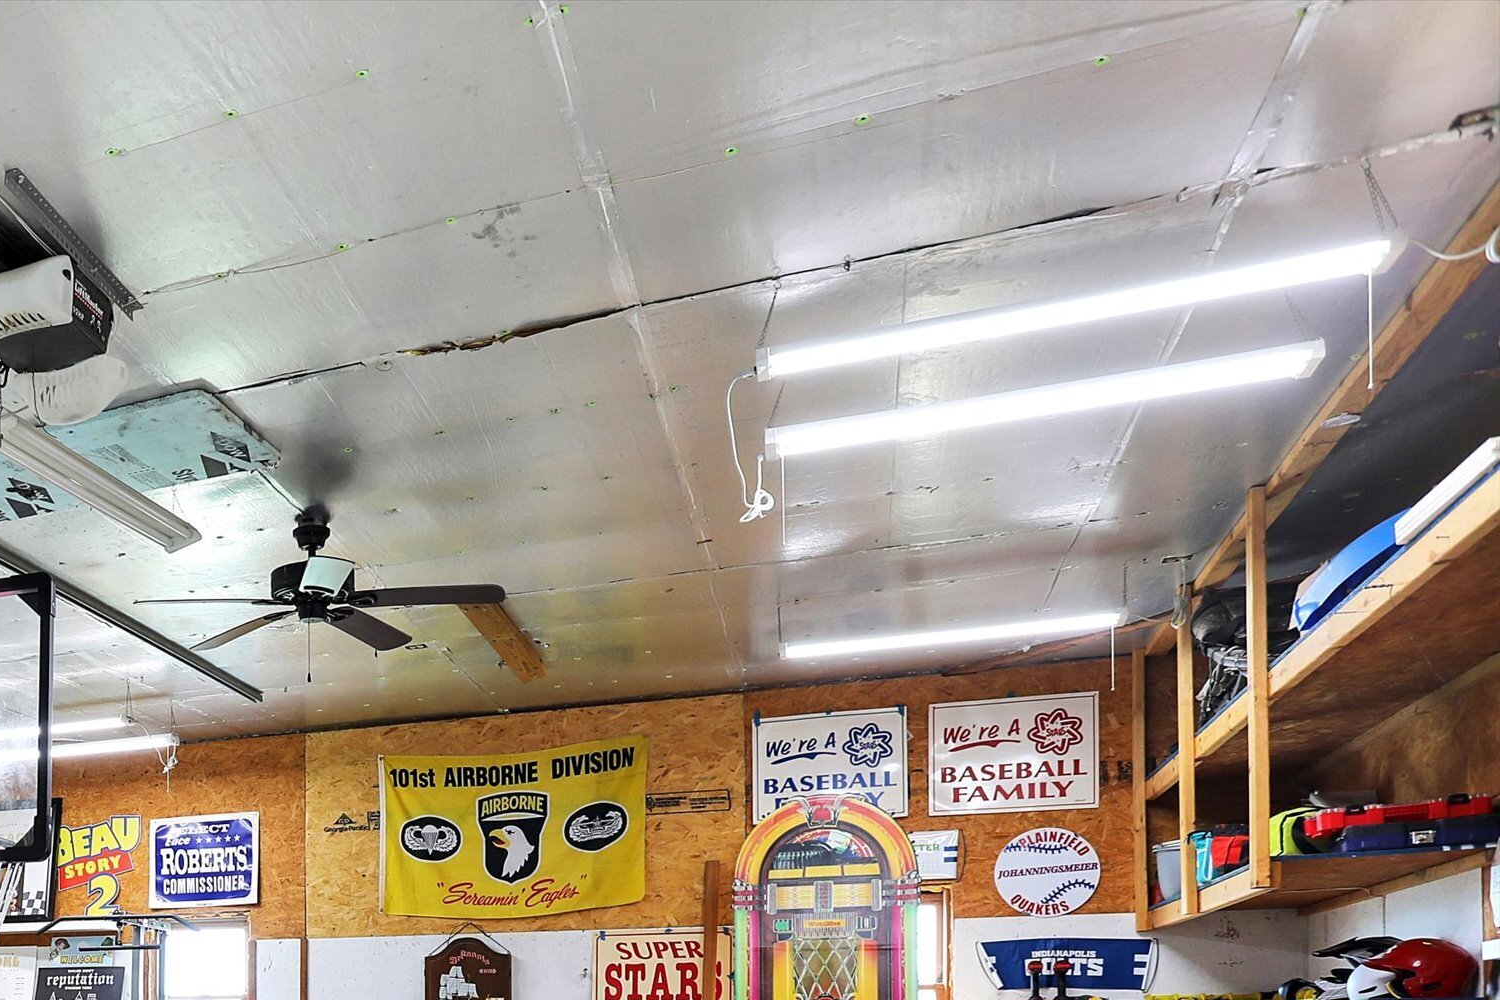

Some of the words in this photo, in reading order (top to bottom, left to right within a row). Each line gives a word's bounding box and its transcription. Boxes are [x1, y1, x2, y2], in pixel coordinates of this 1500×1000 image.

[17, 482, 49, 500] DW
[943, 723, 1000, 744] We're
[1007, 718, 1021, 736] A
[766, 737, 818, 757] We're
[824, 731, 837, 749] A
[389, 768, 436, 788] 101st
[444, 761, 538, 788] AIRBORNE
[552, 747, 635, 780] DIVISION
[940, 758, 1088, 783] BASEBALL
[763, 771, 898, 794] BASEBALL
[952, 780, 1075, 803] FAMILY
[481, 795, 545, 818] AIRBORNE
[57, 815, 142, 868] BEAU
[1018, 830, 1090, 857] PLAINFIELD
[64, 854, 122, 880] STORY
[160, 845, 248, 876] ROBERTS
[997, 862, 1099, 880] JOHANNINGSMEIER
[84, 872, 120, 916] 2
[163, 874, 246, 895] COMMISSIONER
[1010, 894, 1070, 916] QUAKERS
[60, 953, 104, 964] WELCOME
[615, 940, 704, 960] SUPER
[1031, 950, 1097, 958] INDIANAPOLIS
[46, 971, 115, 989] reputation
